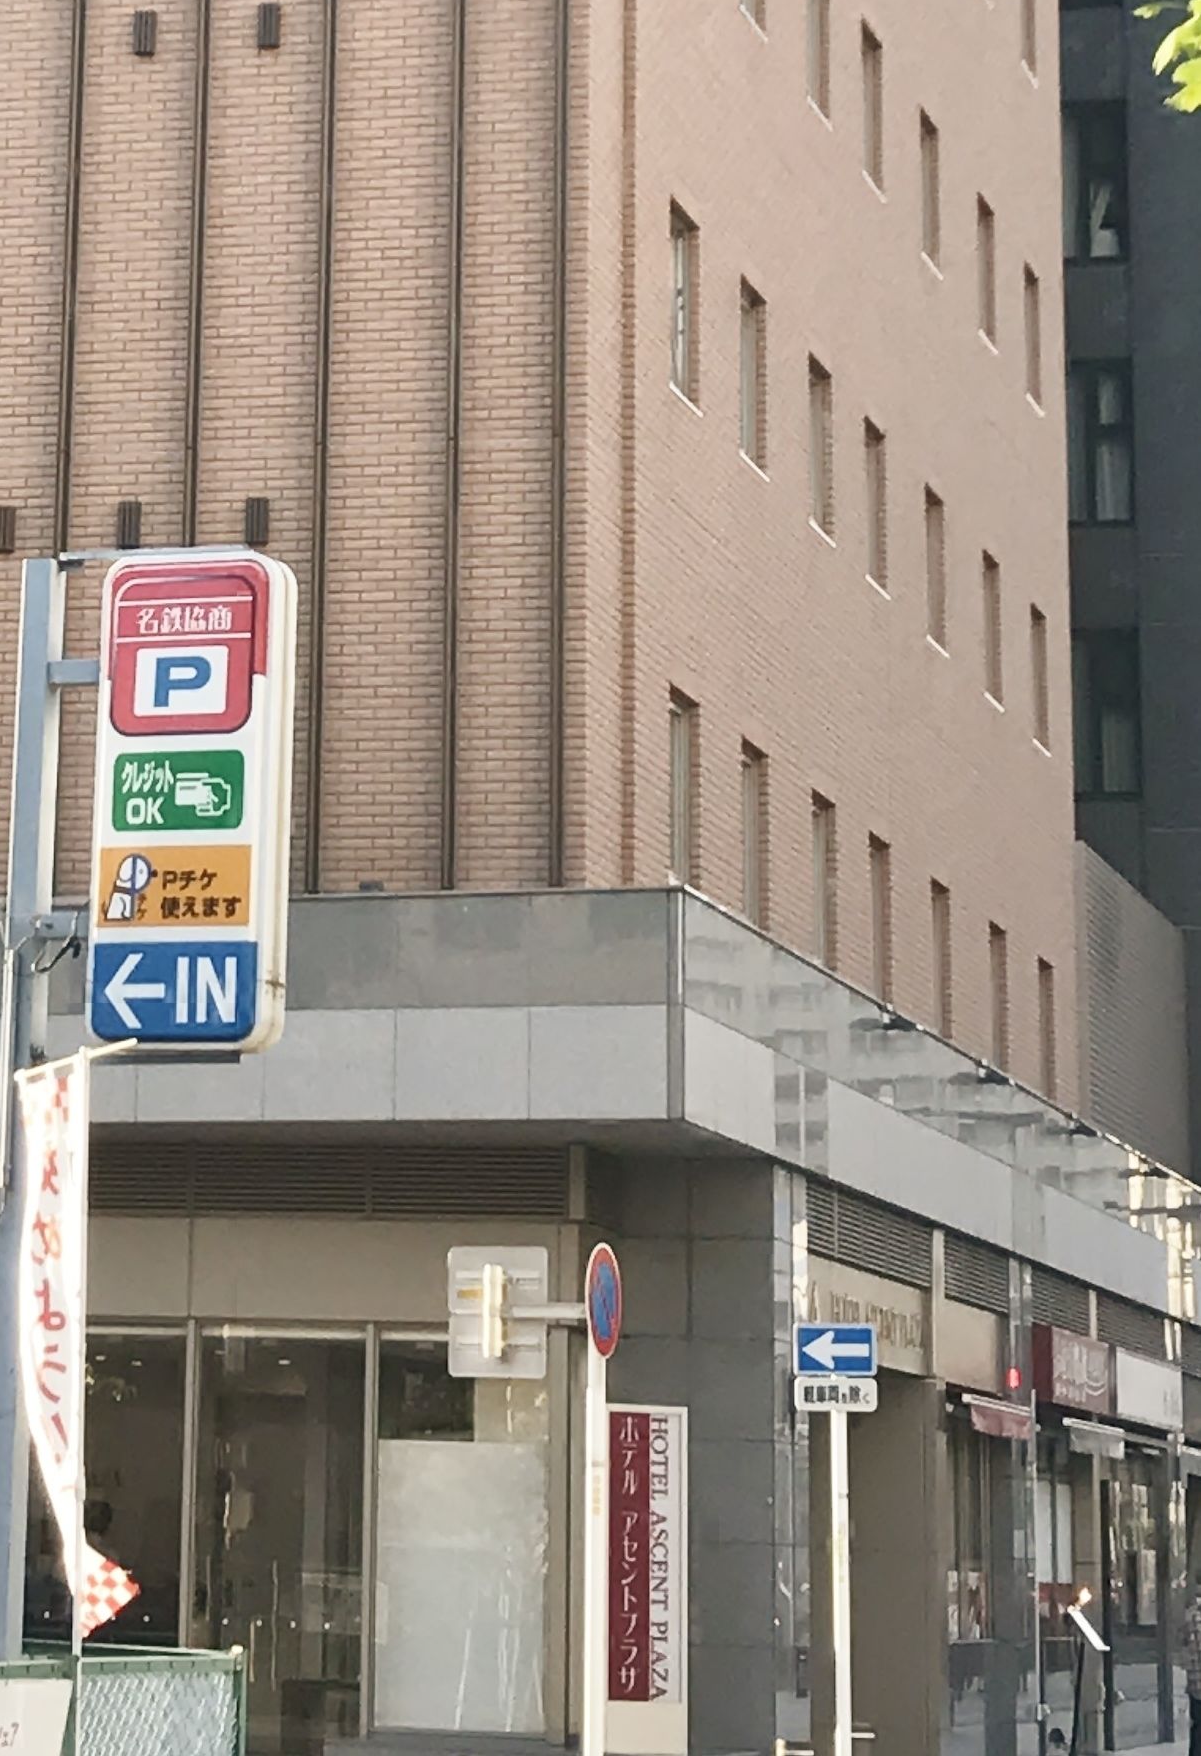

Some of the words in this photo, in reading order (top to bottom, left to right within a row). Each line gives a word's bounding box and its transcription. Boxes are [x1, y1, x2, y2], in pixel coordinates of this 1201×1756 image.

[135, 604, 233, 633] 名鉄協商
[153, 655, 212, 708] P
[121, 761, 174, 794] クレジット
[125, 797, 164, 825] OK
[162, 868, 218, 891] Pチケ
[160, 895, 242, 919] 使えます
[176, 956, 238, 1024] IN
[804, 1385, 871, 1404] 軽車両を除く
[619, 1416, 639, 1495] ホテル
[650, 1415, 668, 1500] HOTEL
[650, 1513, 669, 1611] ASCENT
[650, 1621, 670, 1700] PLAZA
